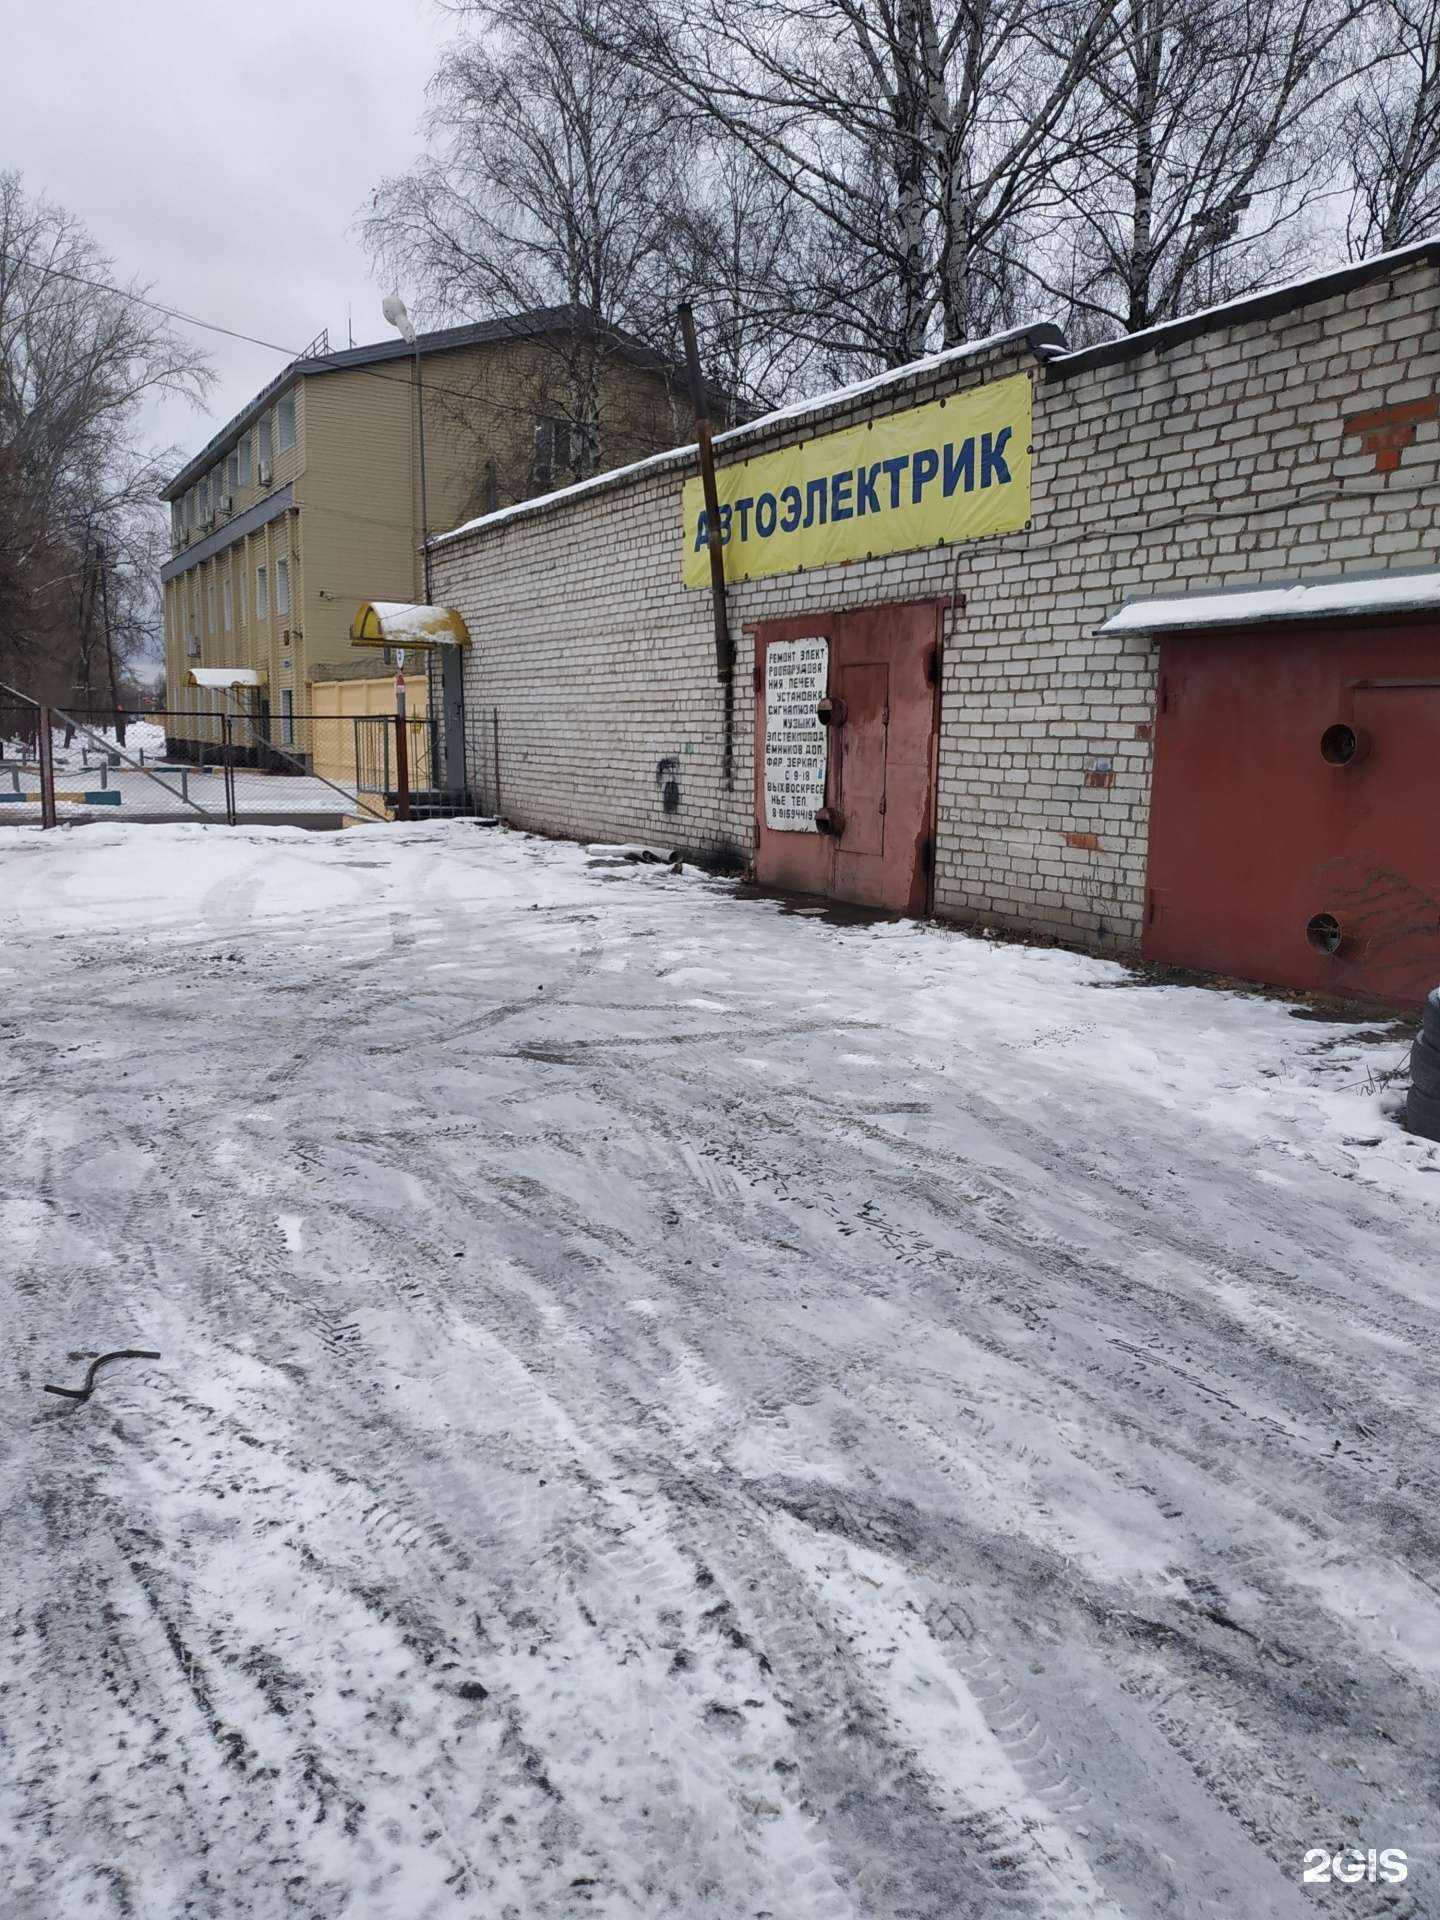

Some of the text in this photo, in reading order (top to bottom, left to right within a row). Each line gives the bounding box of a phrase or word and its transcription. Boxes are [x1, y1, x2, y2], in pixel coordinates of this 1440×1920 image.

[693, 426, 1013, 552] АВТОЭЛЕКТРИК
[769, 648, 825, 664] РЕМОНТ ЭЛЕКТ
[768, 677, 815, 690] НИЯ ПЕЧЕК
[776, 690, 822, 702] УСТАНОВКА
[782, 717, 817, 729] МУЗЫКИ
[786, 757, 818, 768] ЗЕРКАЛ
[784, 770, 790, 780] С
[771, 795, 786, 806] НЬЕ
